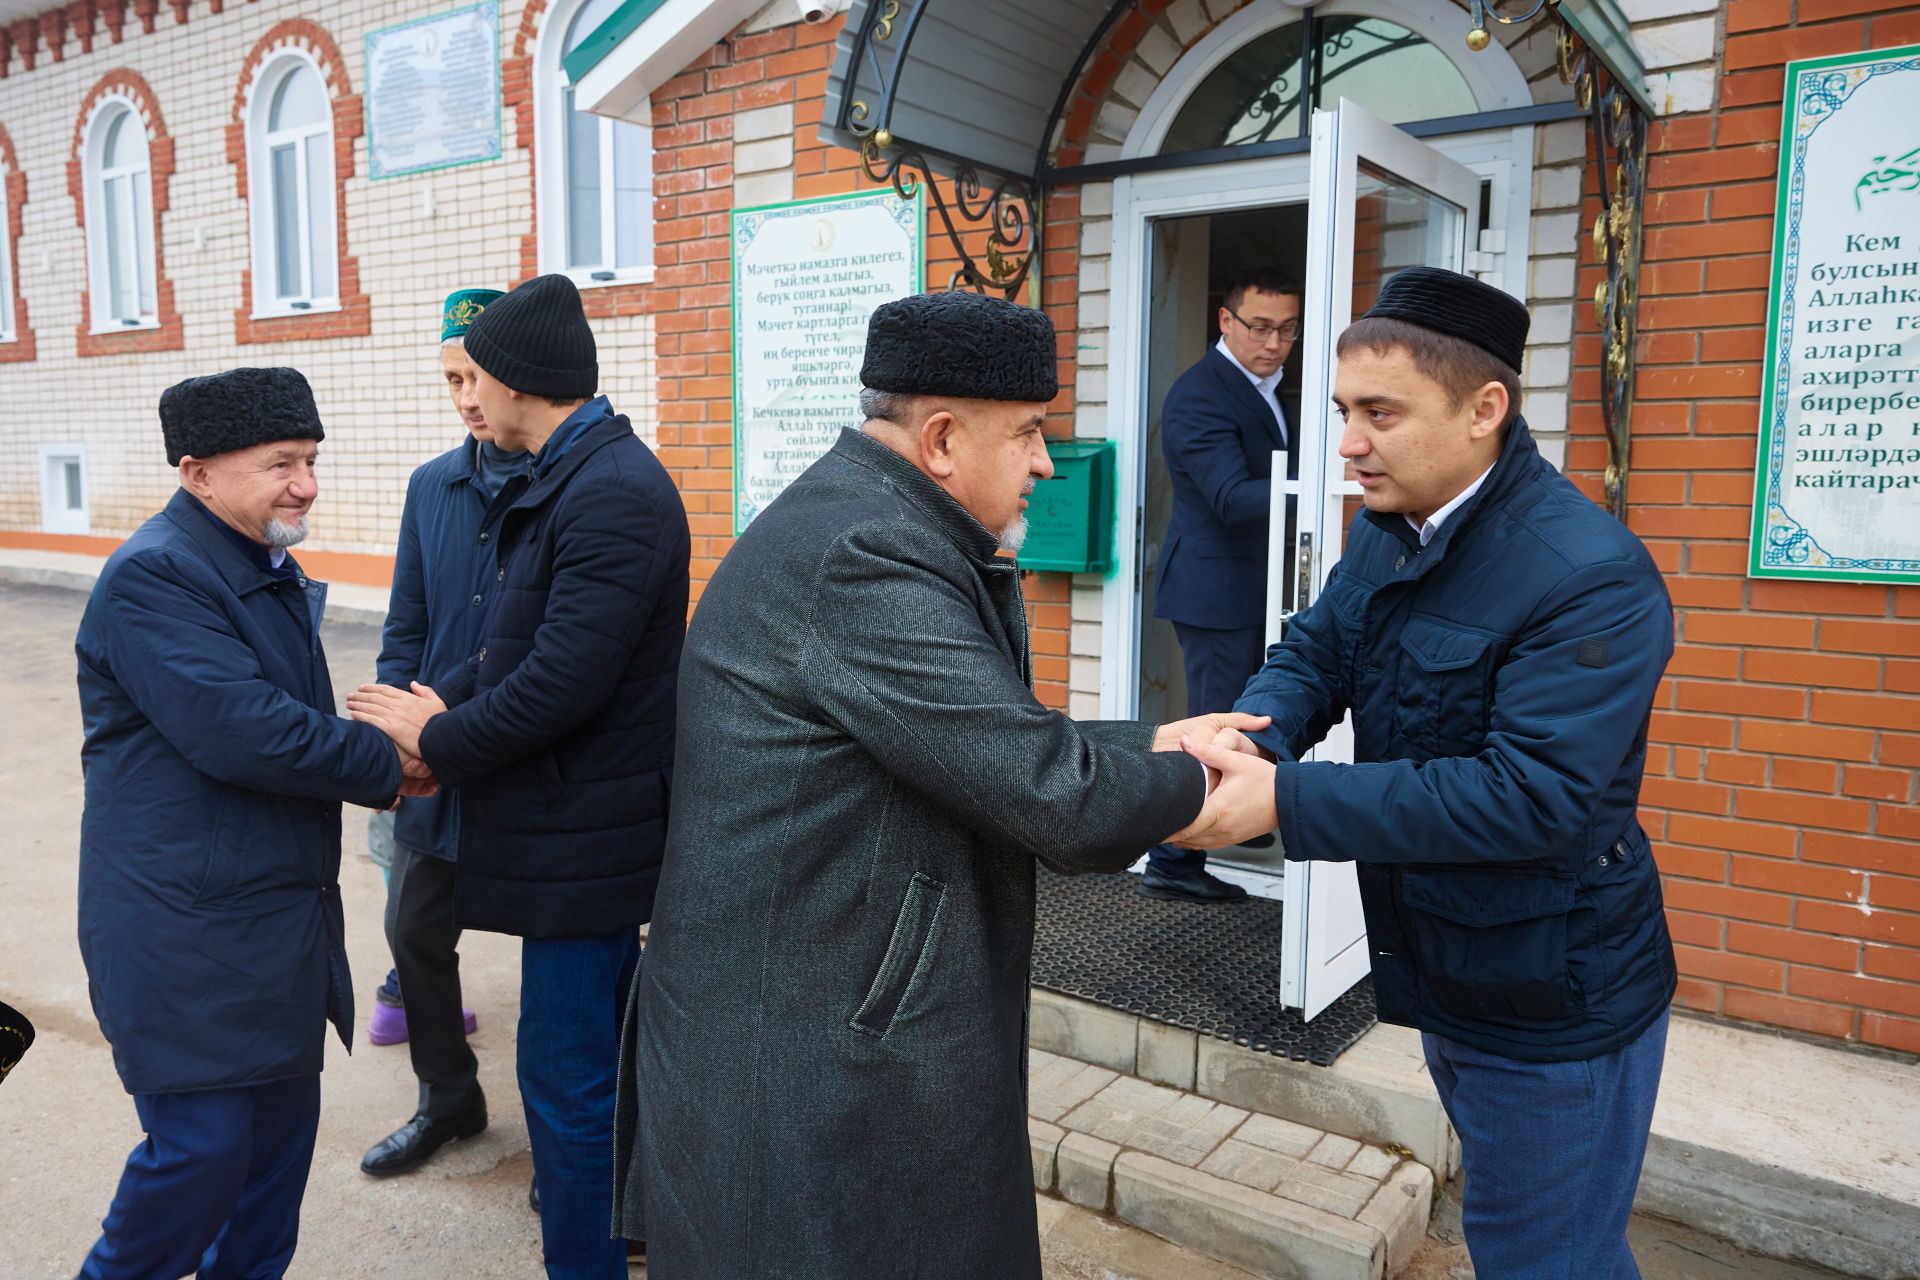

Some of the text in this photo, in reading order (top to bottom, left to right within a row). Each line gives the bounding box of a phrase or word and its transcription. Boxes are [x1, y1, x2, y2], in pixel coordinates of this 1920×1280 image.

[1845, 234, 1901, 253] Кем
[747, 251, 905, 277] Мәчеткә намазга килегез,
[1811, 261, 1919, 286] булсын
[774, 269, 874, 288] гыйлем алыгыз,
[793, 287, 826, 302] соңга
[829, 283, 894, 298] калмагыз,
[1808, 284, 1920, 308] Аллаһк
[792, 298, 852, 318] туганнар!
[757, 319, 793, 332] Мәчет
[796, 315, 858, 331] картларга
[1807, 317, 1873, 334] изге
[763, 350, 779, 361] иң
[781, 346, 830, 361] беренче
[1804, 342, 1902, 363] аларга
[766, 377, 793, 391] урта
[795, 374, 839, 389] буынга
[752, 407, 800, 419] Кечкенә
[803, 406, 854, 418] вакытта
[1801, 391, 1920, 416] бирербе
[1798, 422, 1883, 441] алар
[763, 448, 827, 463] картаймы
